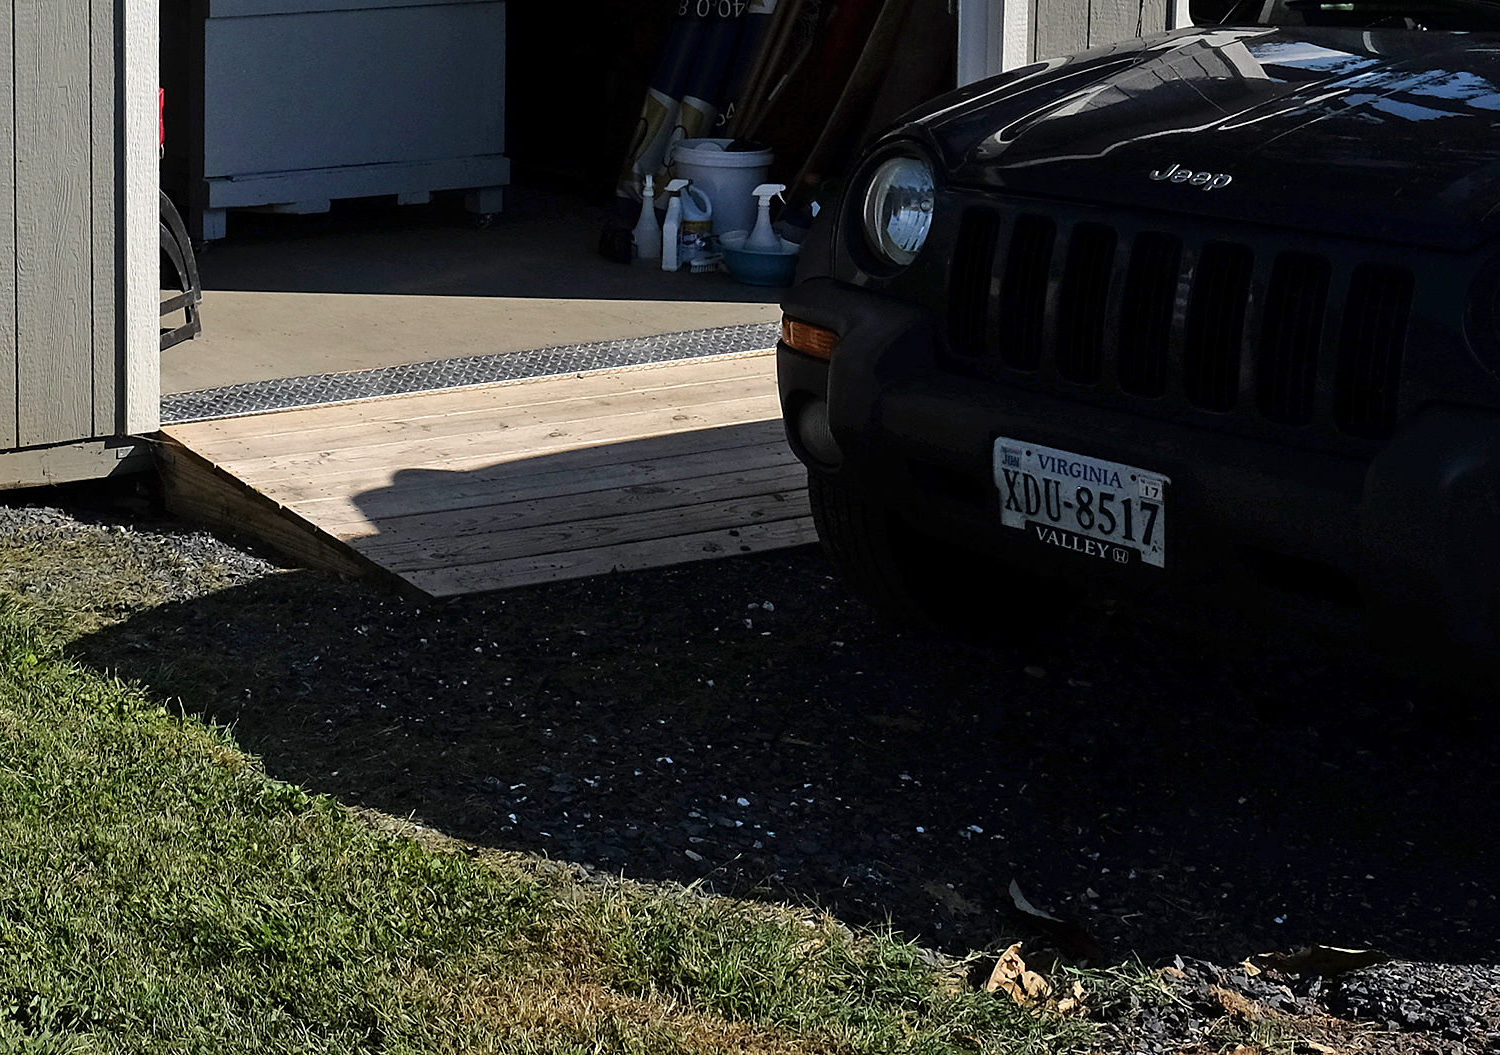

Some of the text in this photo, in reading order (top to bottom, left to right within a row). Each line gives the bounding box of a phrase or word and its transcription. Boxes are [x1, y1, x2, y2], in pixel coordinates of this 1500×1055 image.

[1149, 163, 1233, 192] Jeep
[1037, 453, 1123, 489] VIRGINIA
[1001, 467, 1160, 546] XDU-8517
[1145, 485, 1159, 498] 17
[1035, 526, 1110, 559] VALLEY
